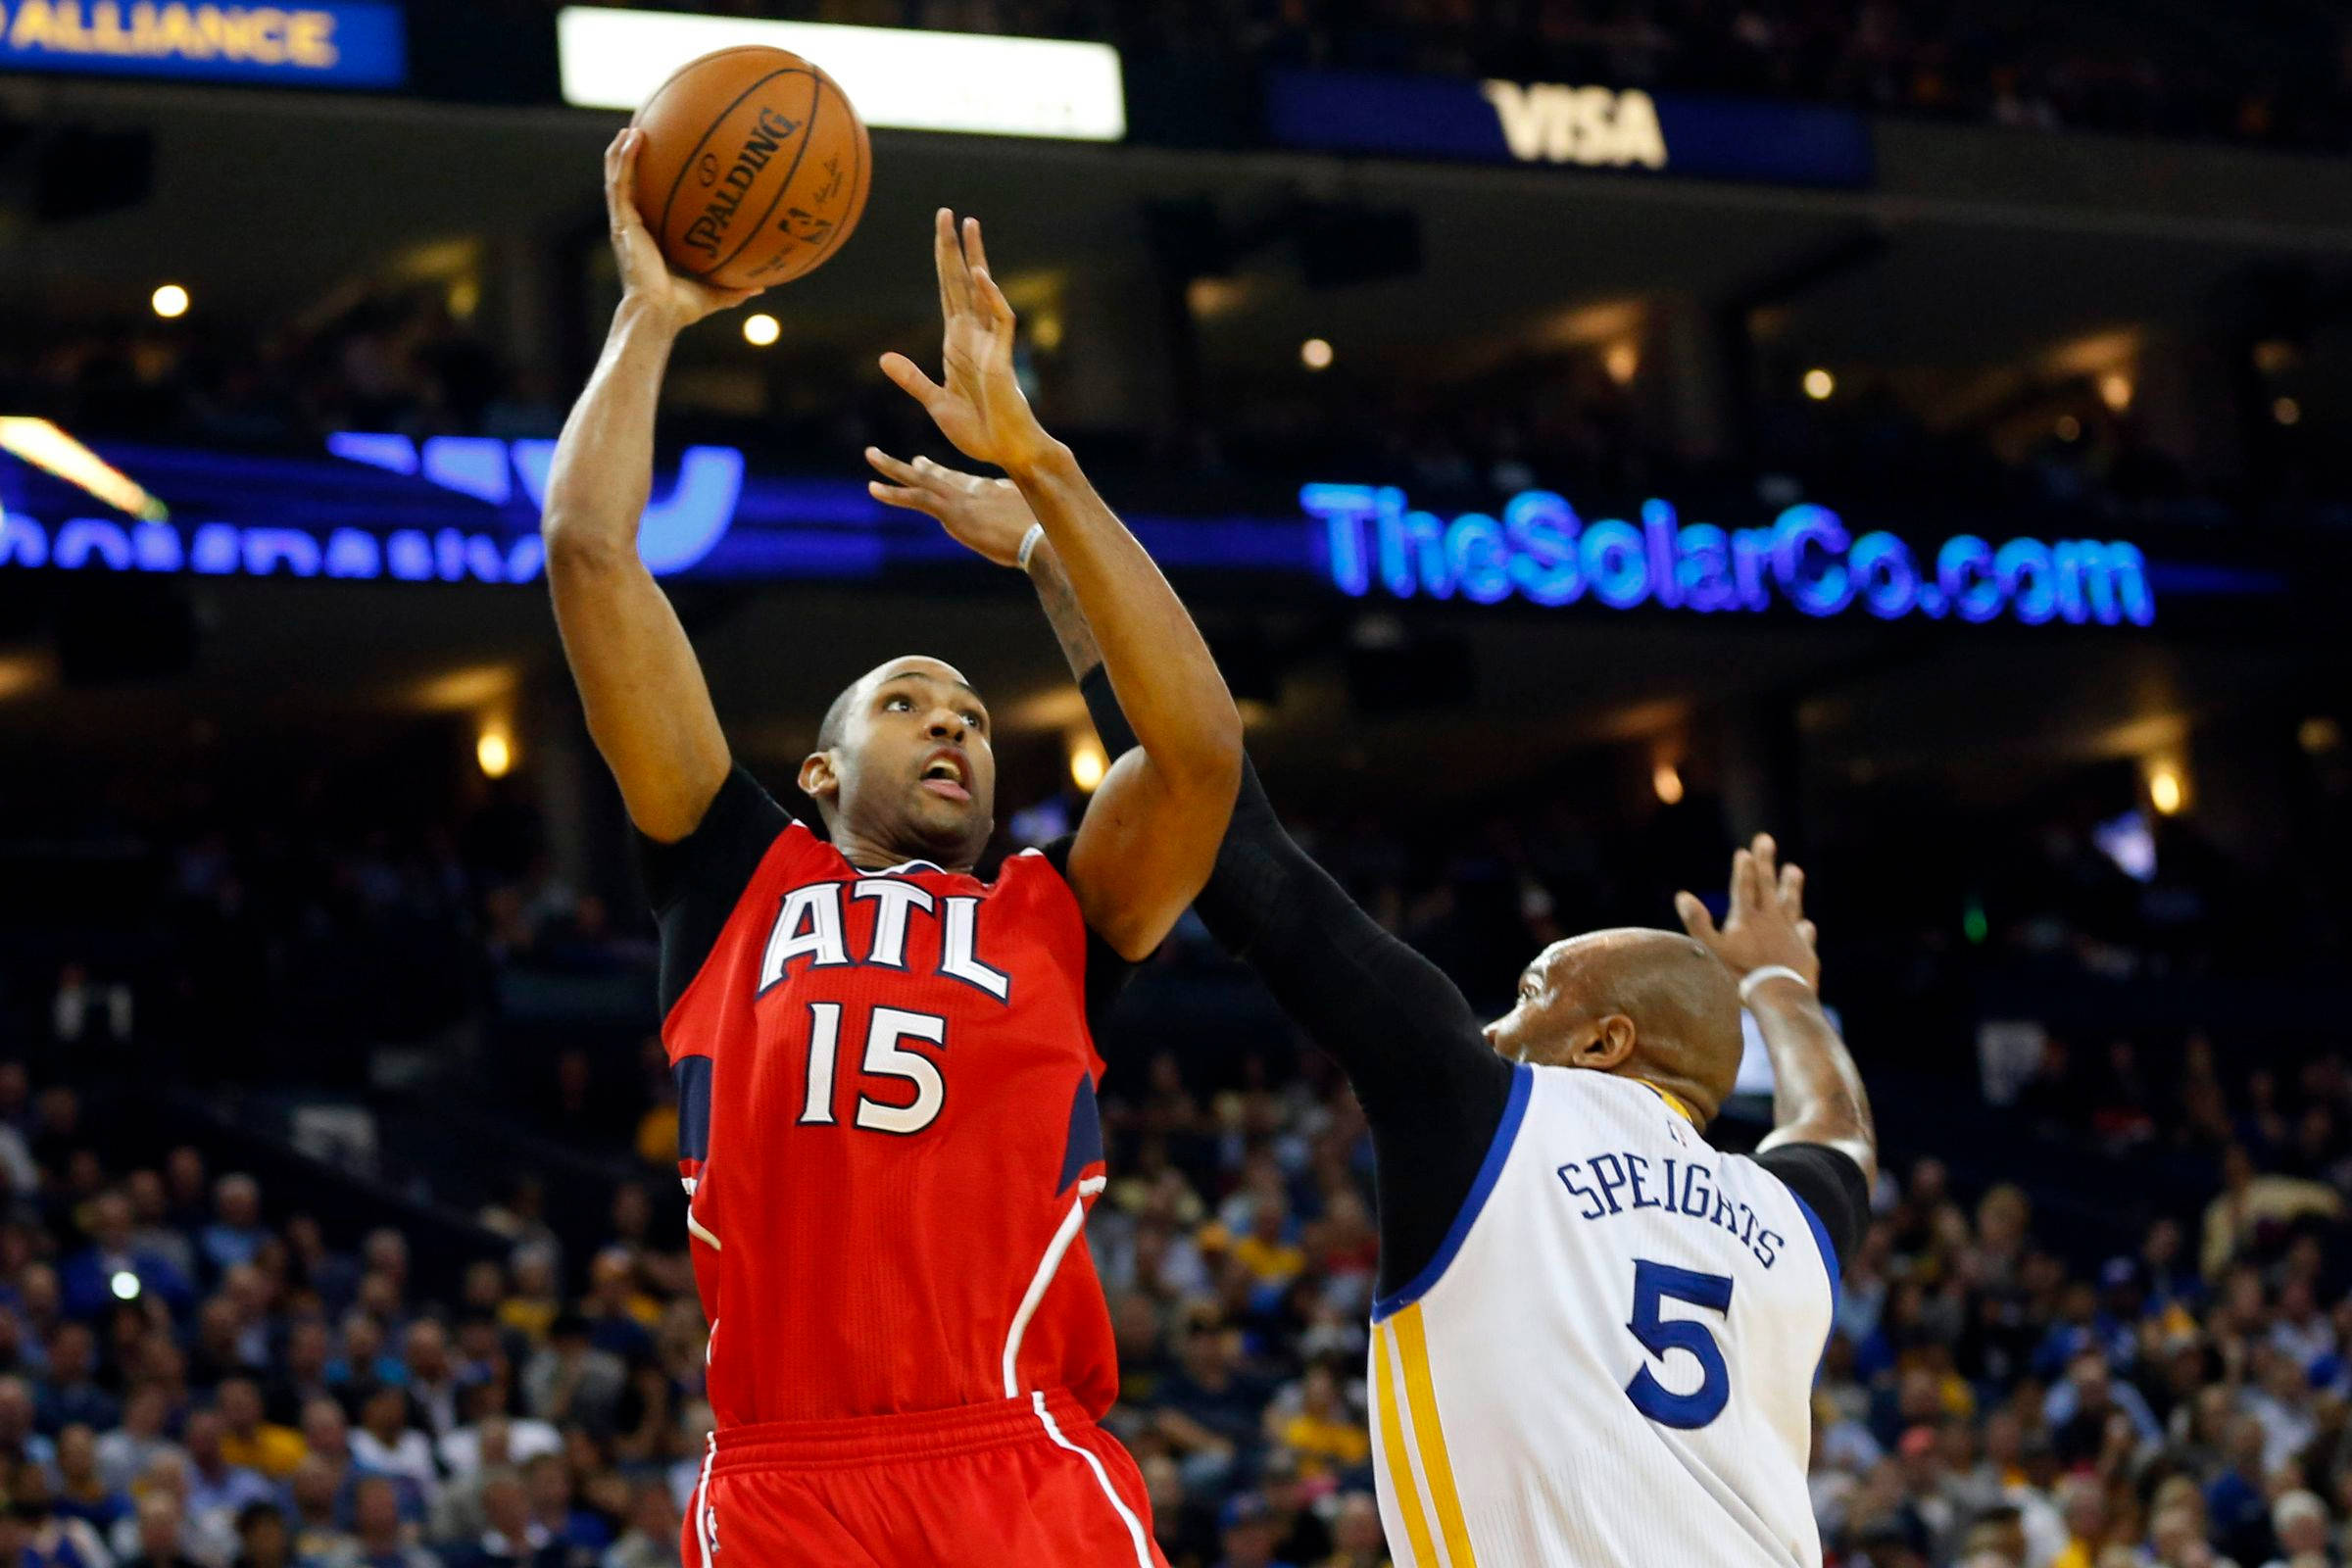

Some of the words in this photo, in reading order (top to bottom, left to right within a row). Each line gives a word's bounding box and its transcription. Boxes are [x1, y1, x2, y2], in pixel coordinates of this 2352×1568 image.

[9, 0, 338, 69] ALLIANCE
[684, 108, 799, 258] SPALDING
[1485, 79, 1667, 169] VISA
[1299, 482, 2155, 625] TheSolarCo.com
[756, 879, 1010, 1006] ATL
[796, 1001, 947, 1136] 15
[1557, 1152, 1786, 1269] SPEIGHTS
[1625, 1258, 1734, 1430] 5
